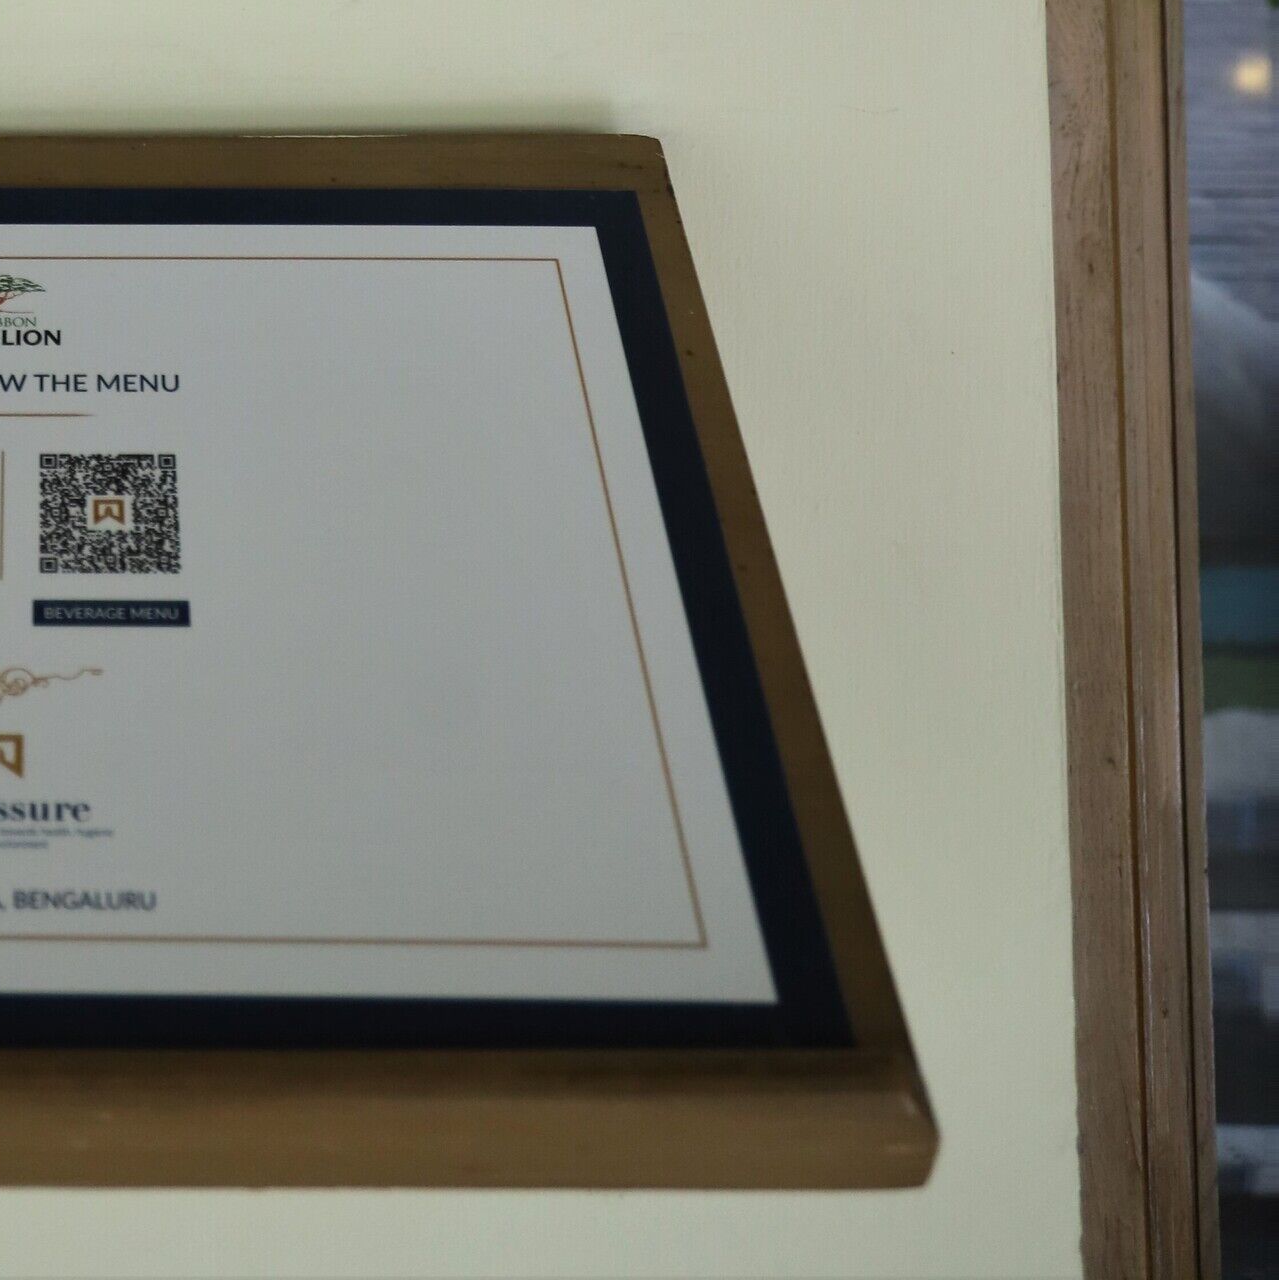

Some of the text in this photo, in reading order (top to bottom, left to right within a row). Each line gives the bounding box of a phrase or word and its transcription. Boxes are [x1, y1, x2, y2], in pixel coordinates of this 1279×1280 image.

[33, 373, 88, 393] THE
[96, 373, 180, 393] MENU
[43, 606, 179, 621] BEVERAGE MENU
[12, 889, 157, 911] BENGALURU
